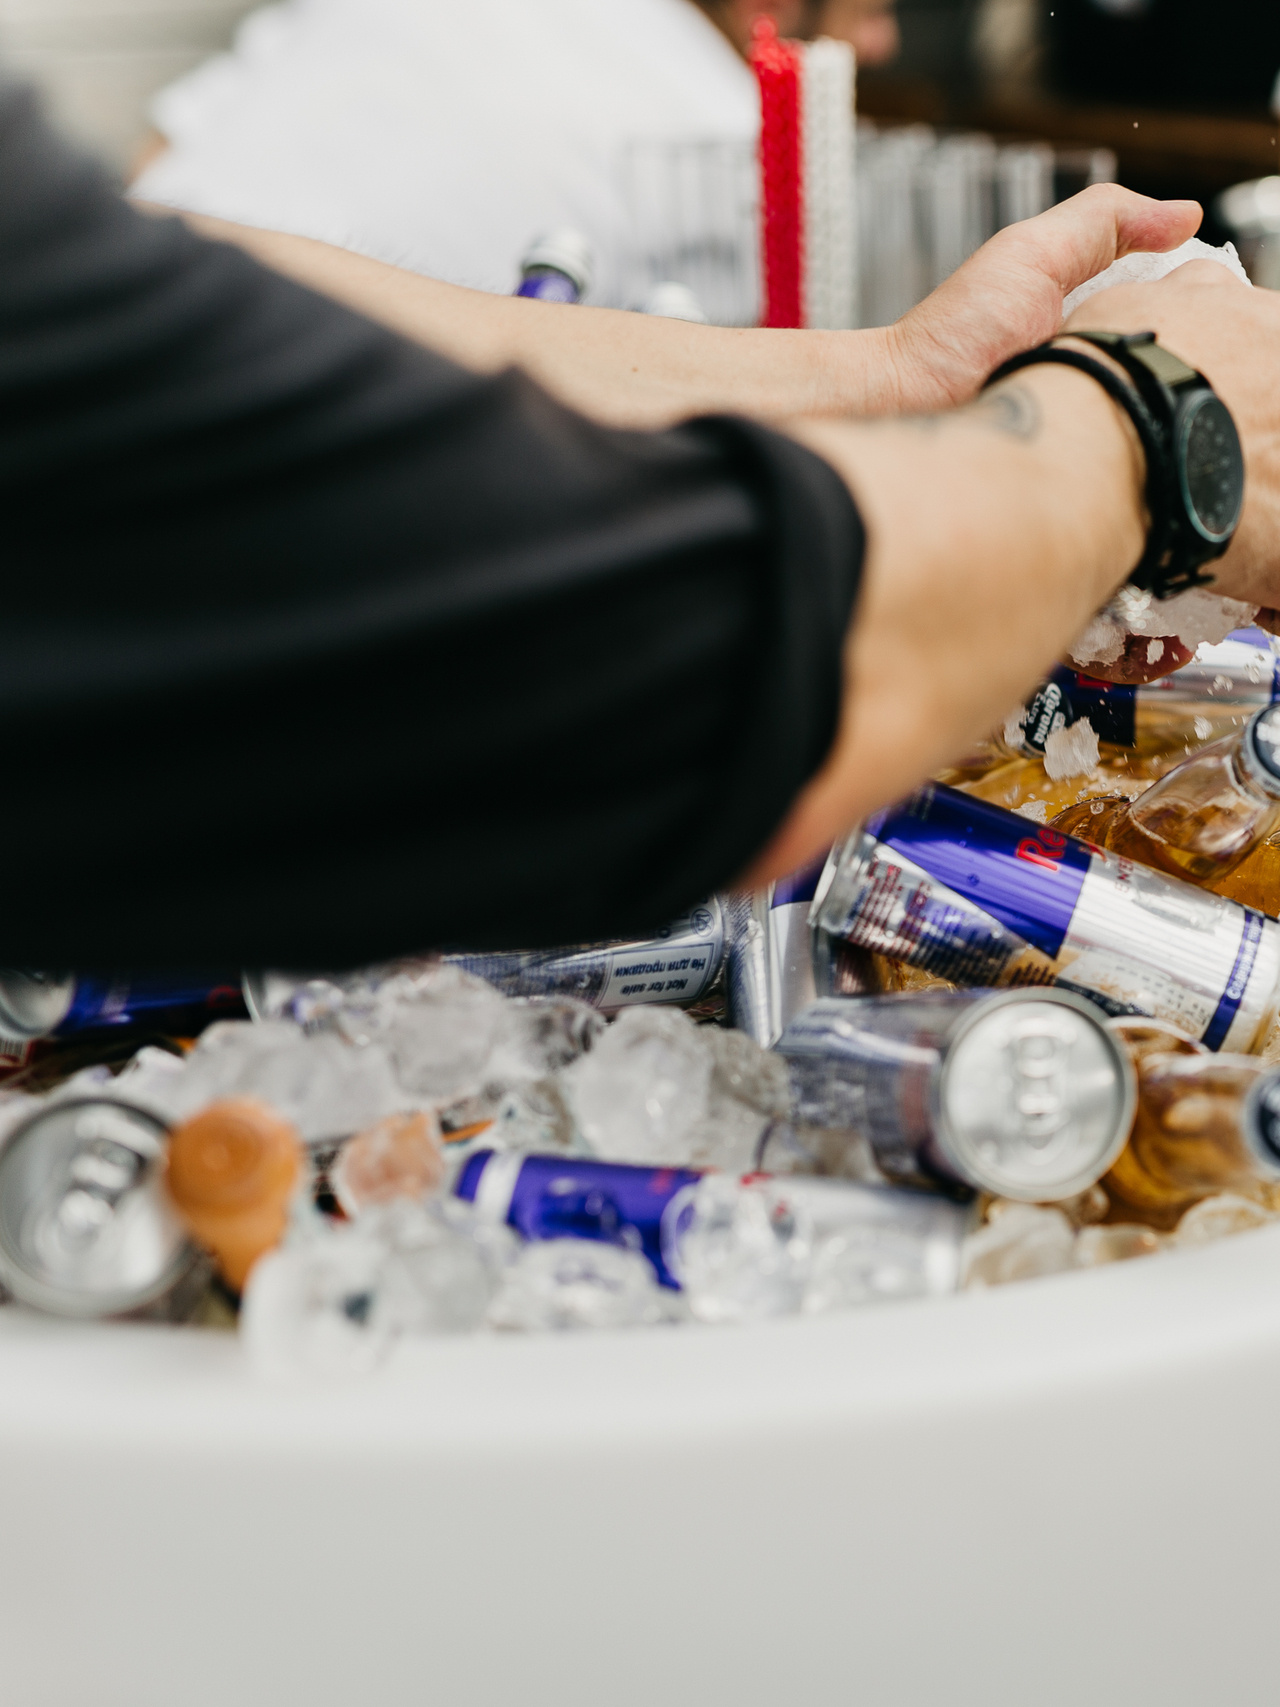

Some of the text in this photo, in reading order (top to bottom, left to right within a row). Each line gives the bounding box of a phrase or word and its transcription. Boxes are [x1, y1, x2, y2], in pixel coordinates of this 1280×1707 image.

[1033, 682, 1062, 744] Corona
[1017, 828, 1066, 872] Re
[614, 957, 707, 978] Не для продажи
[621, 978, 689, 996] Not for sale
